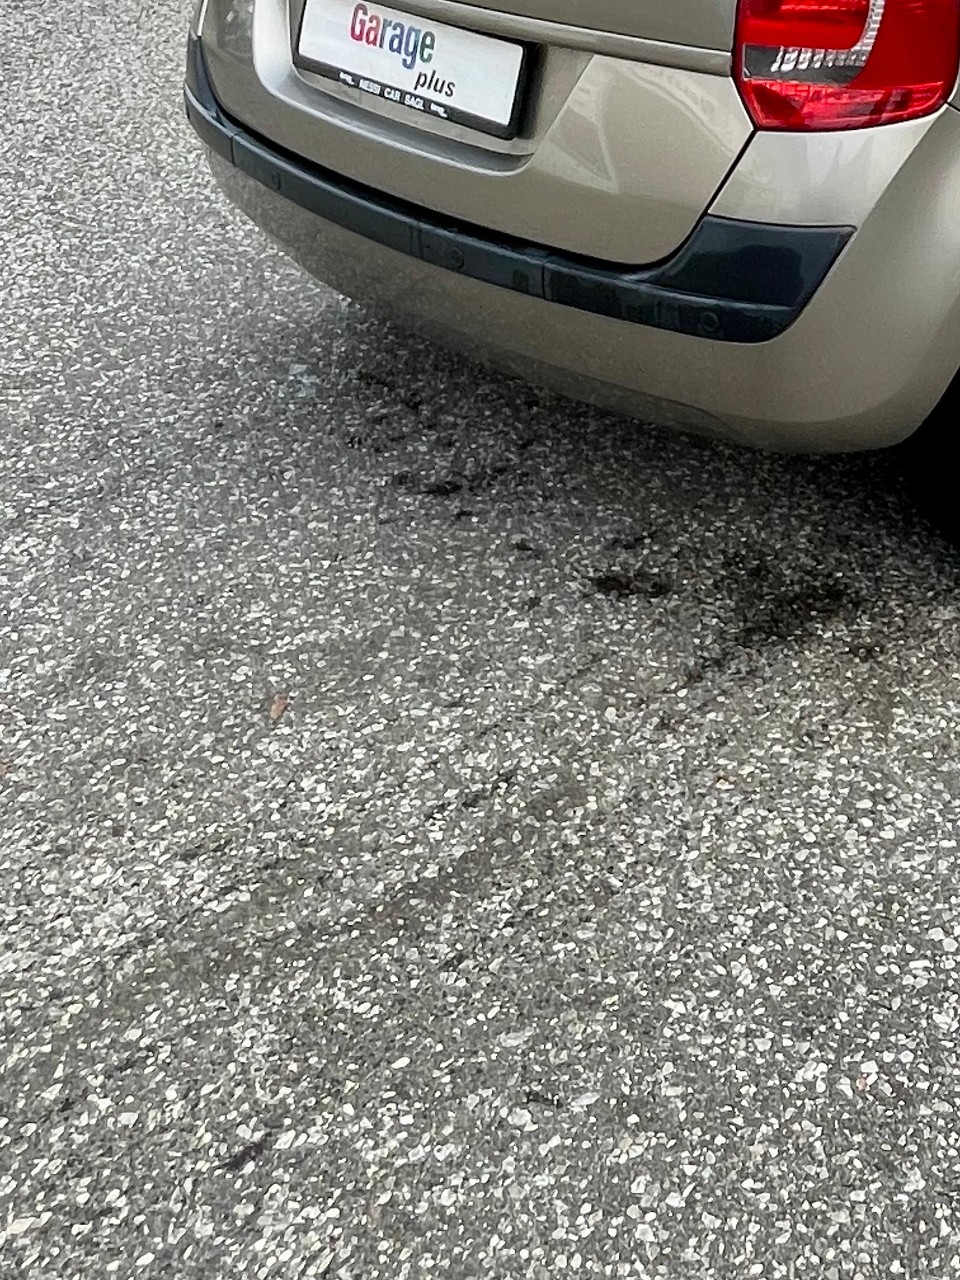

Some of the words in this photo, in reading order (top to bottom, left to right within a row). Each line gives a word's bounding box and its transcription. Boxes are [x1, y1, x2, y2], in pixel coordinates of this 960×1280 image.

[351, 3, 435, 69] Garage
[384, 87, 401, 102] CAR
[414, 70, 455, 97] plus
